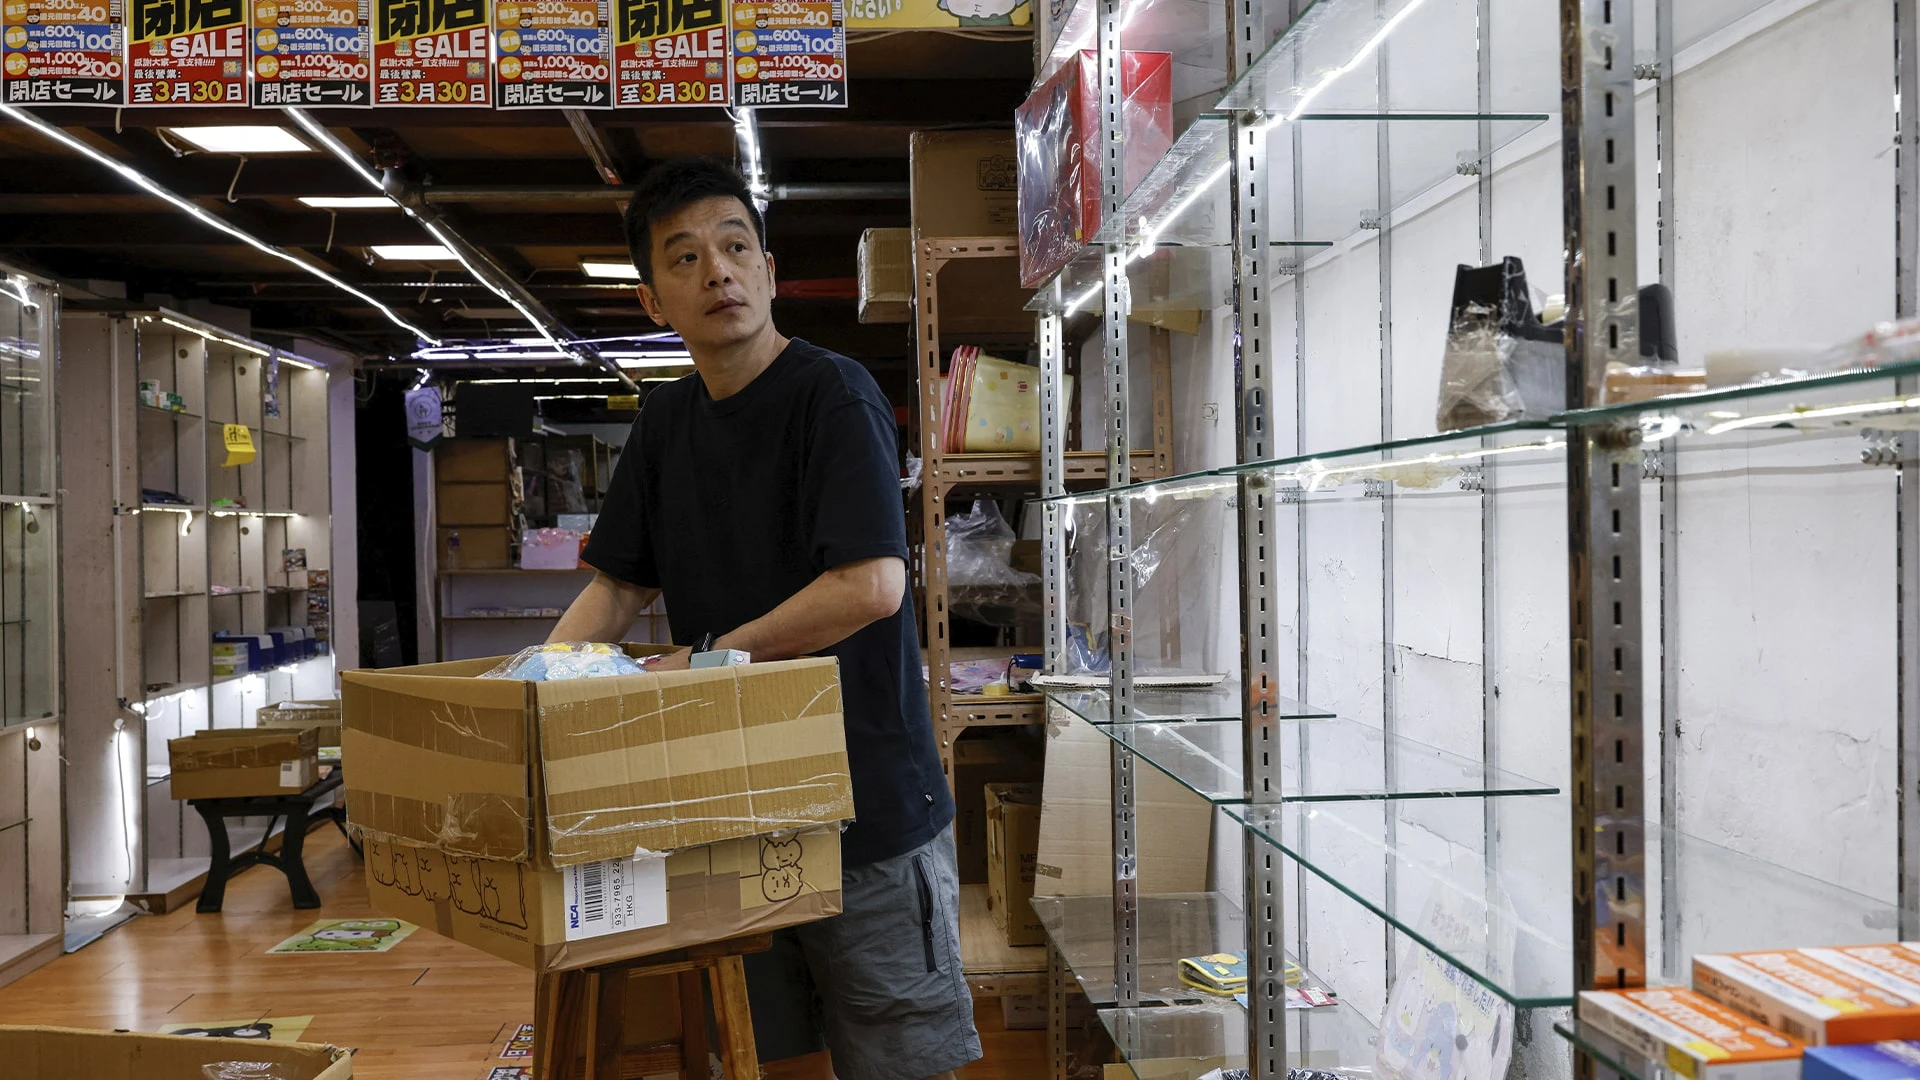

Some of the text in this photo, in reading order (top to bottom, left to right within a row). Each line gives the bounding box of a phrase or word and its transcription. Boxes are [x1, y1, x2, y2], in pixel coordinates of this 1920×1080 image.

[171, 27, 243, 58] SALE
[415, 28, 486, 58] SALE
[654, 28, 724, 58] SALE
[9, 80, 117, 101] 閉店セール
[133, 81, 242, 102] 至3月30日
[261, 82, 364, 104] 閉店セール
[379, 81, 486, 102] 至3月30日
[504, 83, 605, 104] 閉店セール
[620, 81, 724, 103] 至3月30日
[741, 83, 839, 104] 閉店セール
[612, 861, 622, 926] 933-7965 22
[570, 905, 579, 928] NCA
